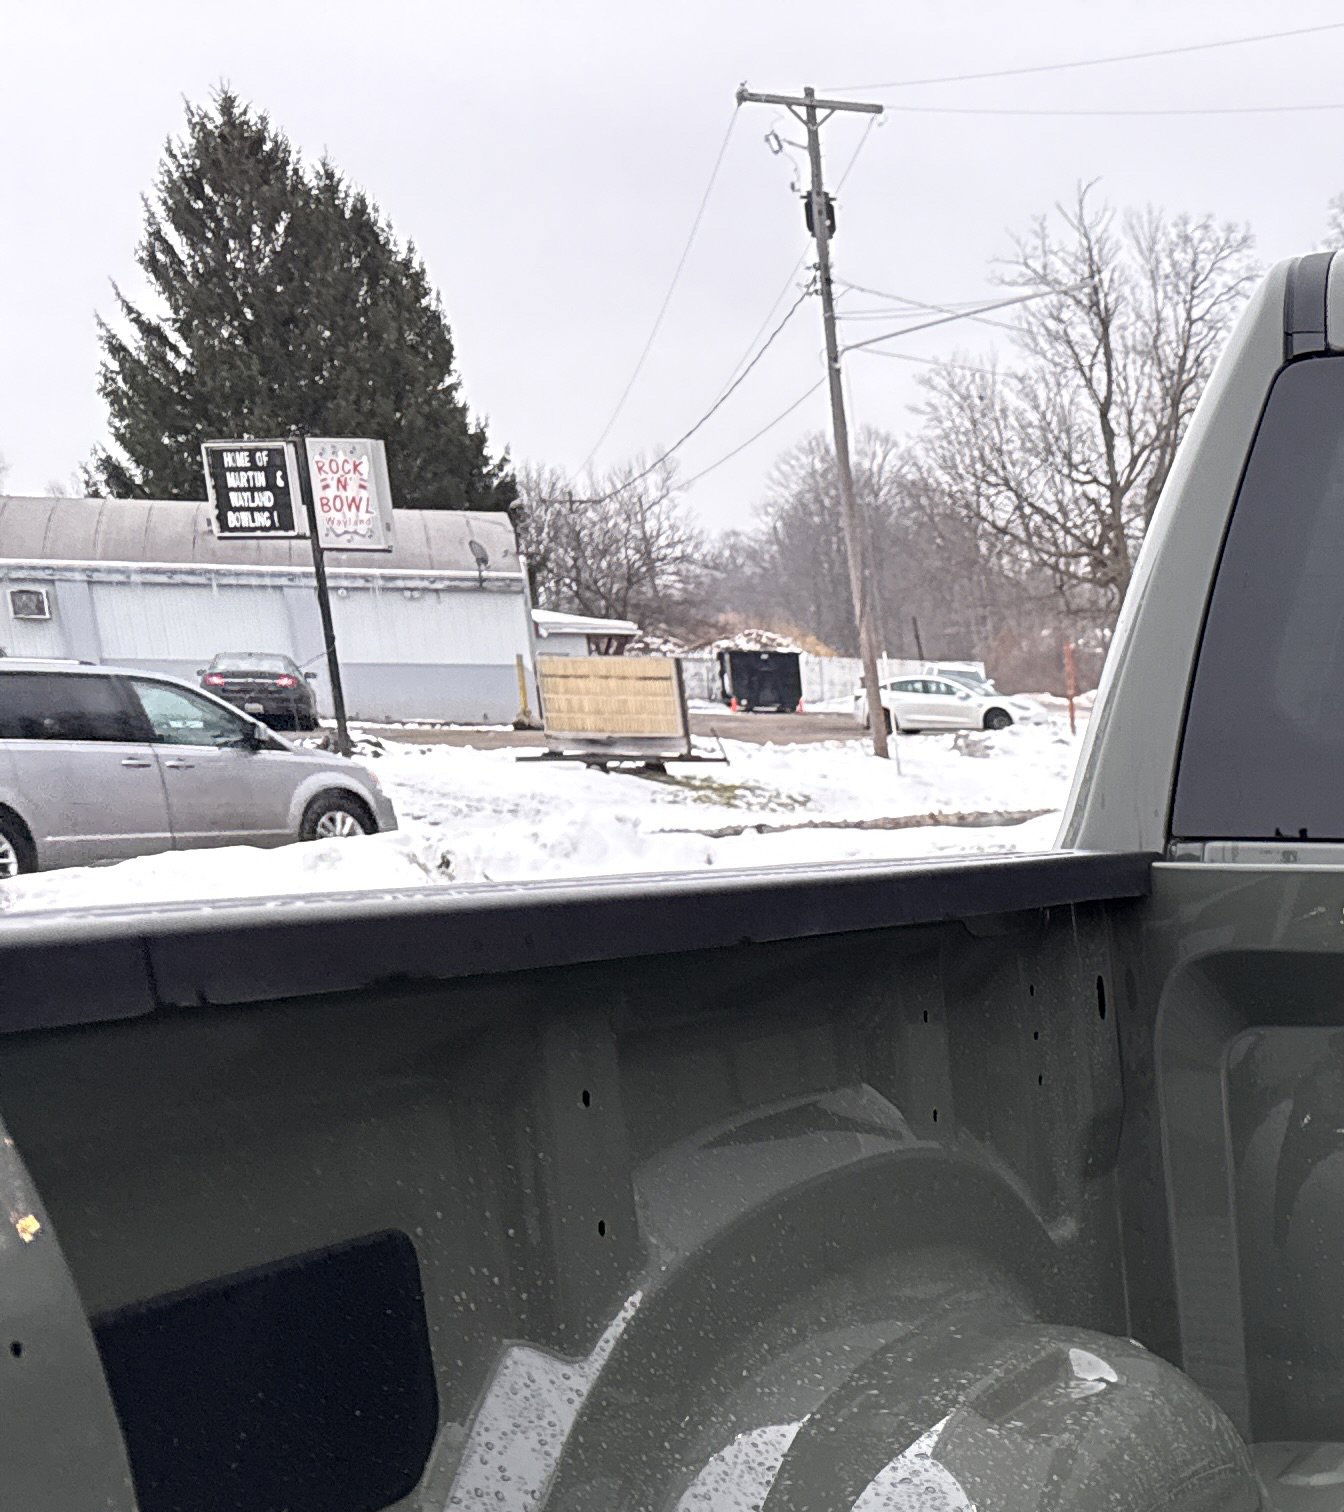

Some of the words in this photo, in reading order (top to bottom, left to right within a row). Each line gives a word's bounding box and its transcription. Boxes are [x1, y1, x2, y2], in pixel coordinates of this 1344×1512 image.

[223, 451, 251, 468] HOME
[255, 450, 269, 467] OF
[315, 458, 363, 476] ROCK
[226, 470, 267, 489] MARTIN
[276, 470, 285, 488] &
[228, 490, 275, 508] WAYLAND
[319, 494, 375, 515] BOWL
[325, 516, 372, 528] Wayland
